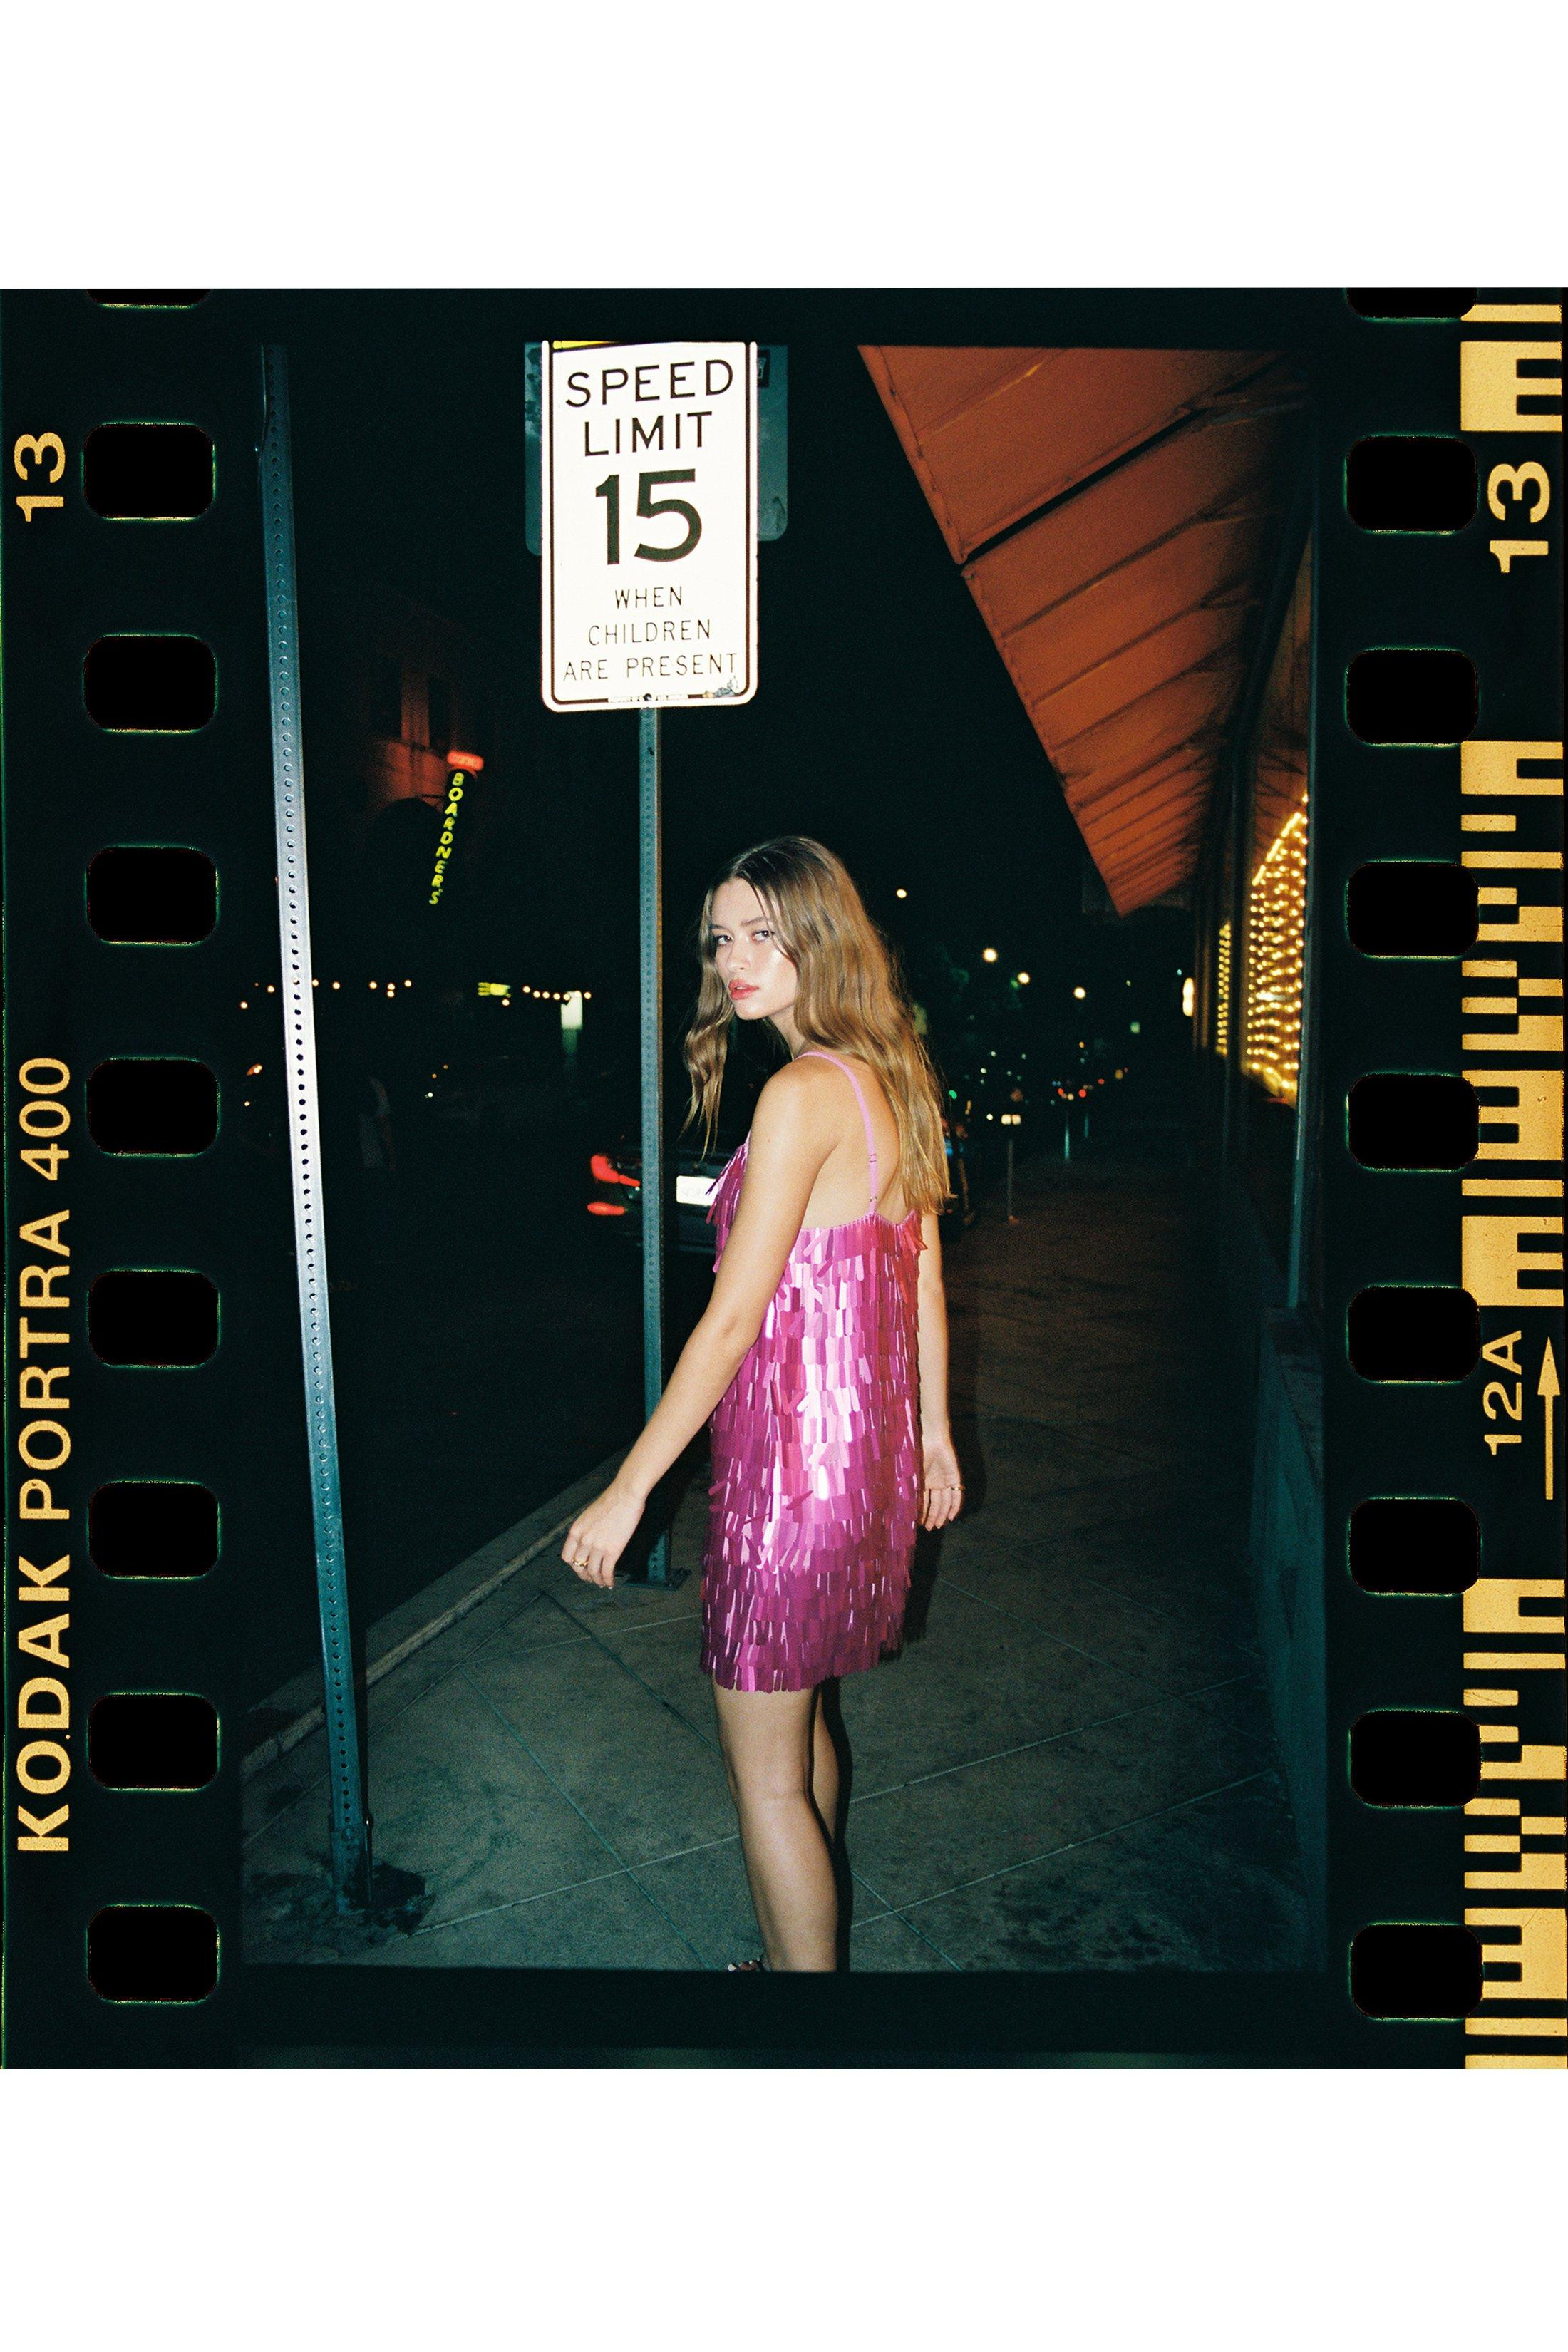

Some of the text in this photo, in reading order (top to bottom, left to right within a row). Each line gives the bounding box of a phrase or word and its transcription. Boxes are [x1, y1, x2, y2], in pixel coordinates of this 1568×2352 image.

[566, 359, 733, 407] SPEED
[585, 411, 712, 456] LIMIT
[14, 433, 65, 522] 13
[596, 468, 702, 565] 15
[1487, 462, 1549, 572] 13
[615, 586, 681, 609] WHEN
[589, 619, 710, 646] CHILDREN
[564, 653, 736, 681] ARE PRESENT
[1482, 1331, 1522, 1455] 12A
[16, 1058, 71, 1851] KODAK PORTRA 400
